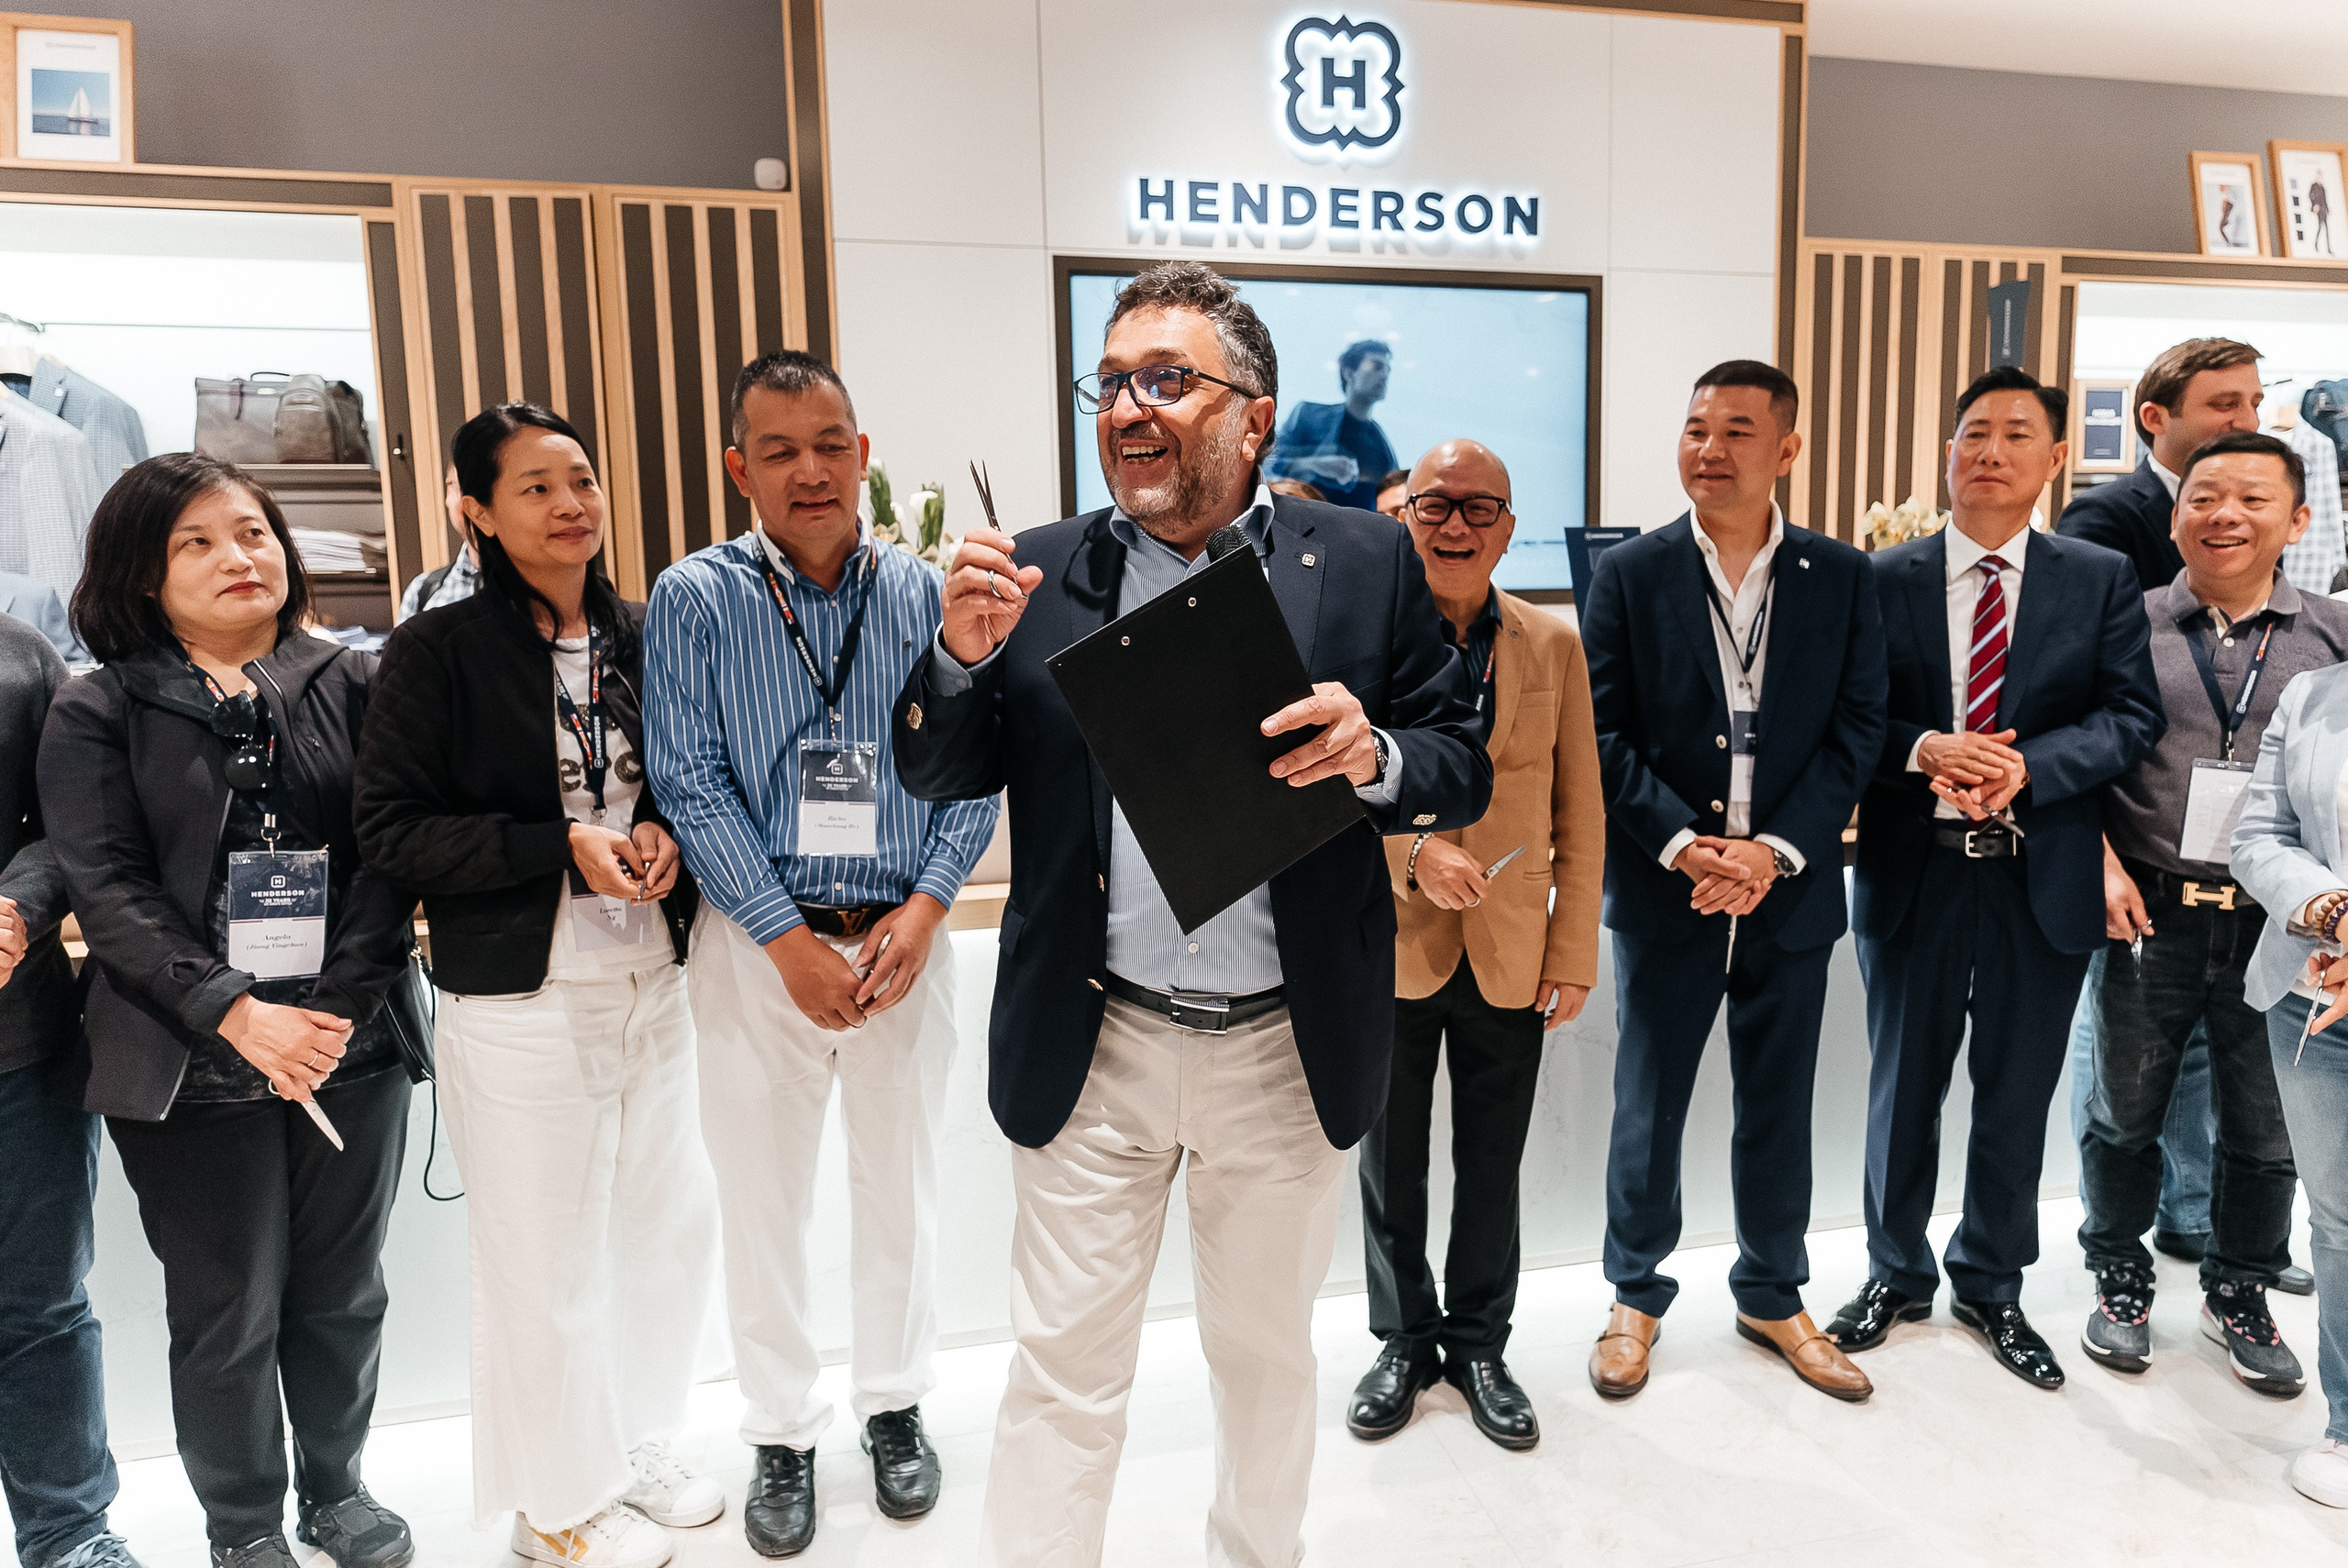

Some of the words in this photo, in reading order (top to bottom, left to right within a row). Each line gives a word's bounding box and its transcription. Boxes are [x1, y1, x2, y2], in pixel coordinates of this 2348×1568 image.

[1320, 57, 1366, 110] H
[1139, 178, 1538, 237] HENDERSON
[250, 889, 305, 898] HENDERSON
